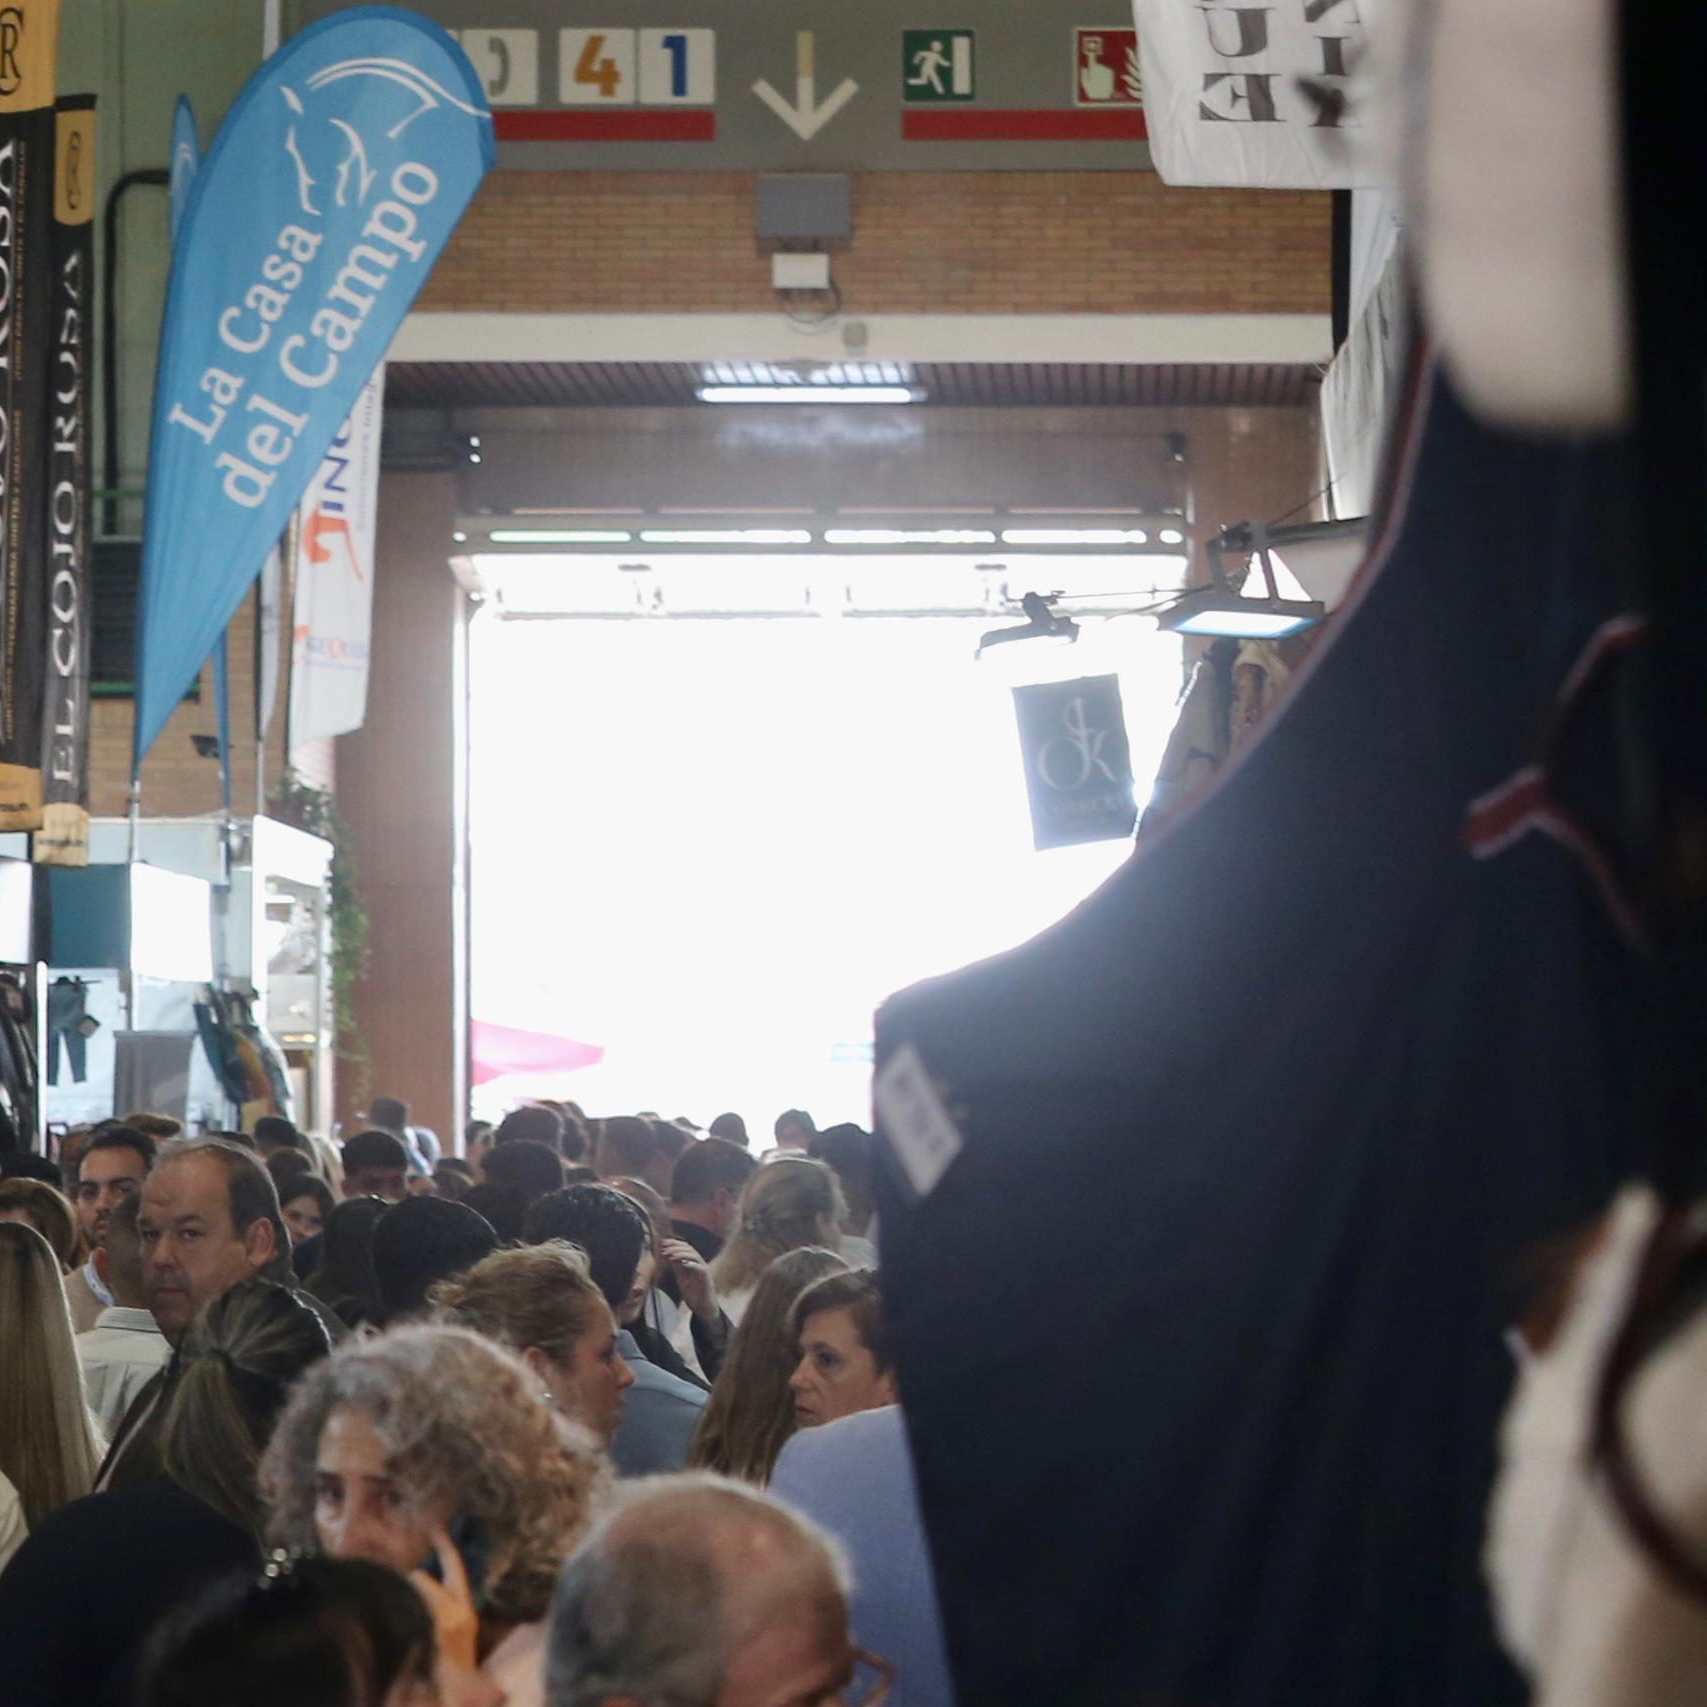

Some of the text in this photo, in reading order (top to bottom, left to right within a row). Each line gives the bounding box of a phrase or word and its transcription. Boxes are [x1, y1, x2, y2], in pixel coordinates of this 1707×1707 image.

[168, 224, 324, 445] La Casa
[215, 161, 439, 509] del Campo
[52, 480, 78, 678] COJO
[52, 697, 76, 783] EL
